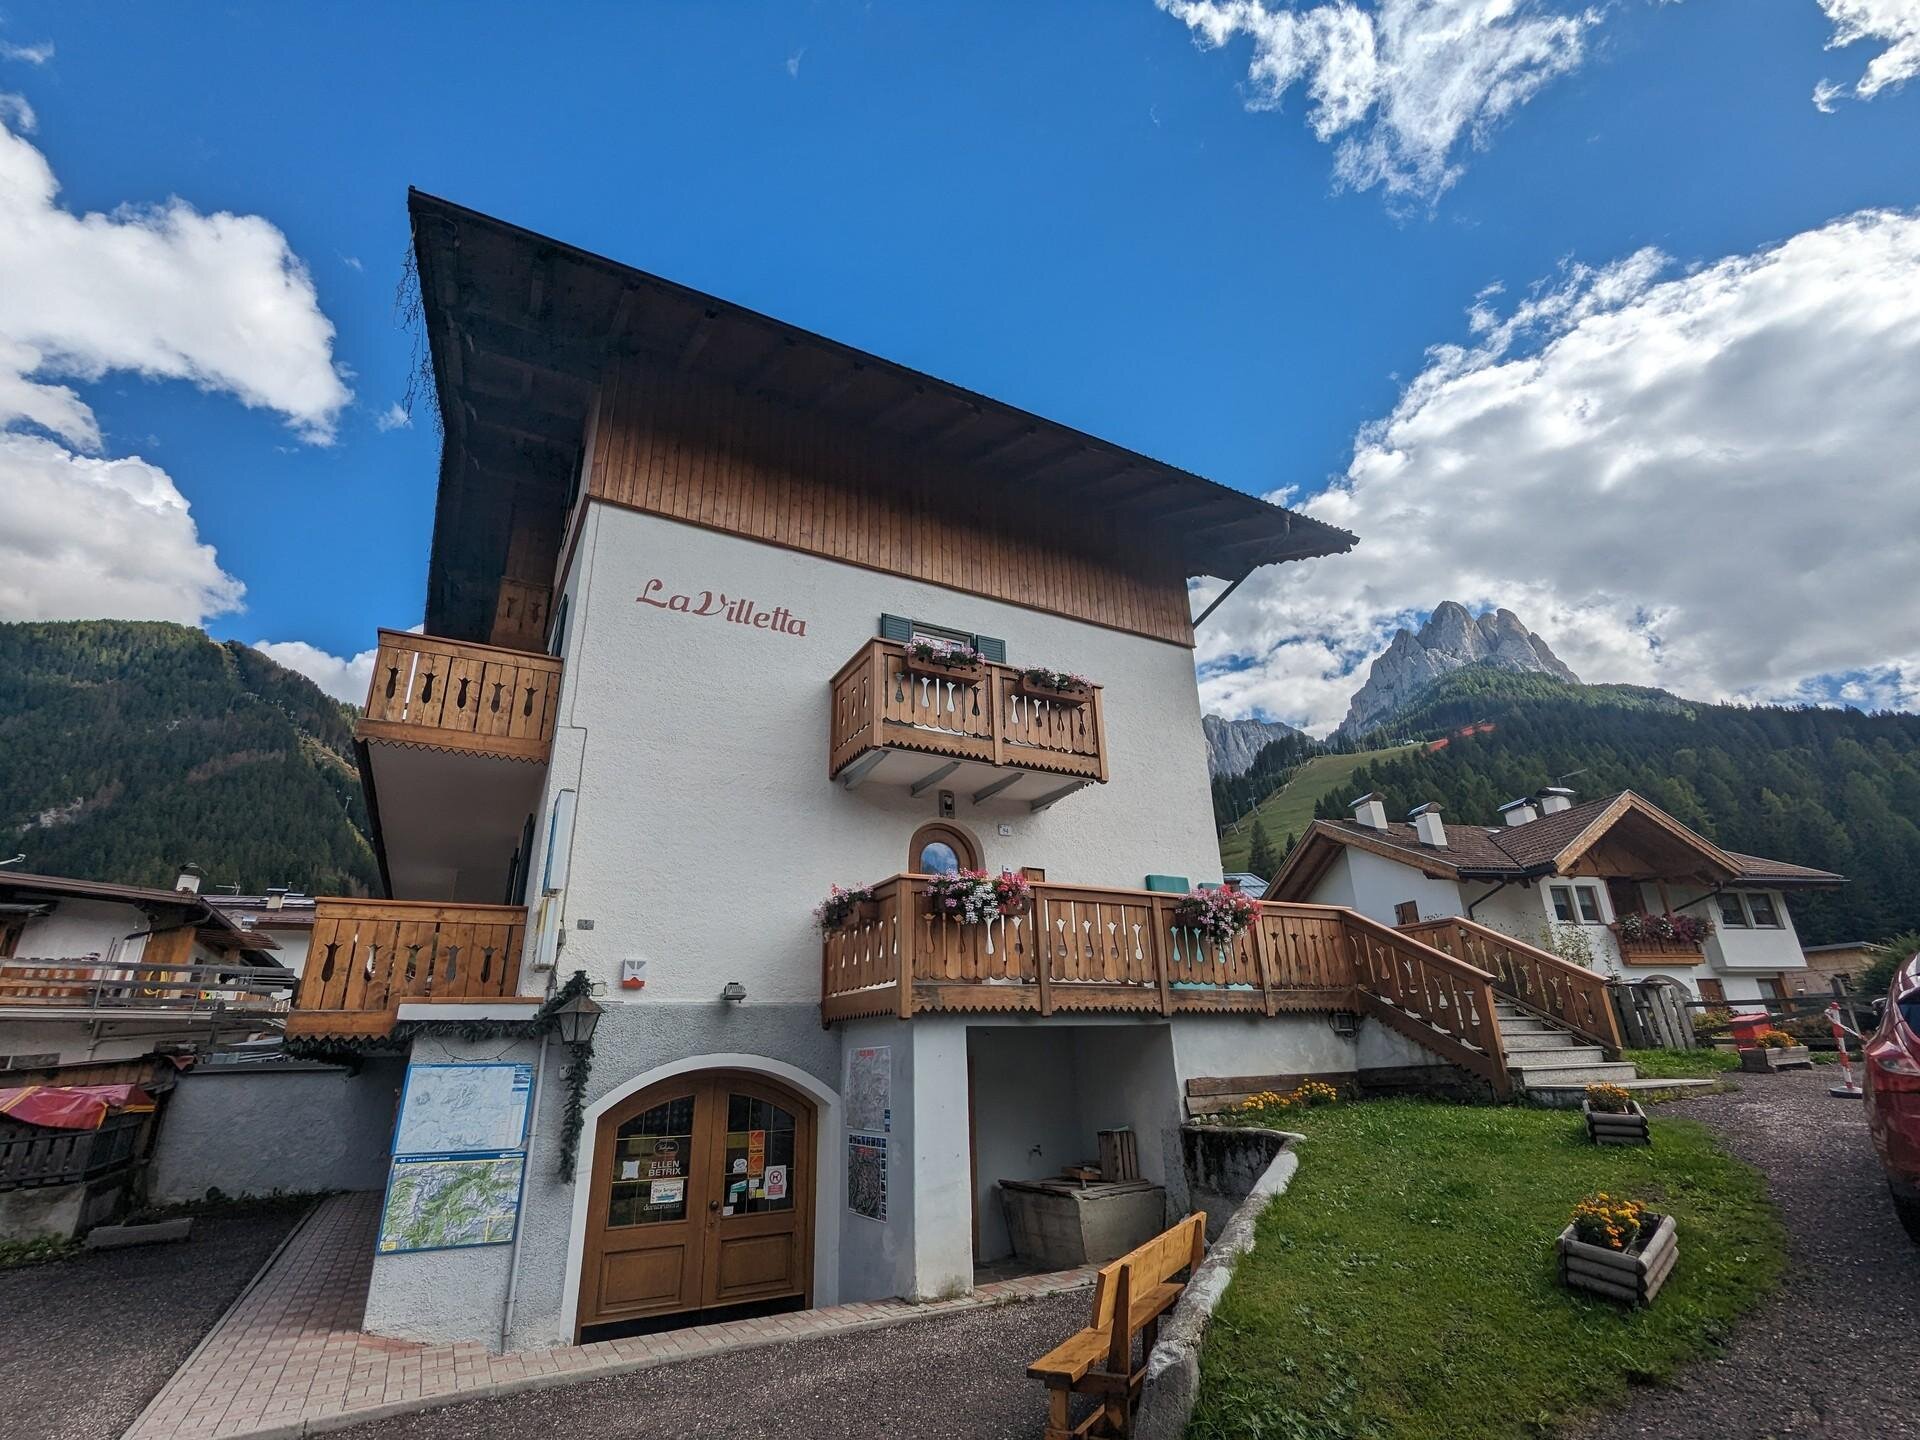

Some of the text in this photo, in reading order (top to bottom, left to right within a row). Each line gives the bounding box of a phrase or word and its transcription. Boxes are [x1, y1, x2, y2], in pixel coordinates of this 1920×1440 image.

[636, 578, 808, 637] La Villetta
[651, 1160, 680, 1169] ELLEN
[648, 1167, 681, 1177] BETRIX
